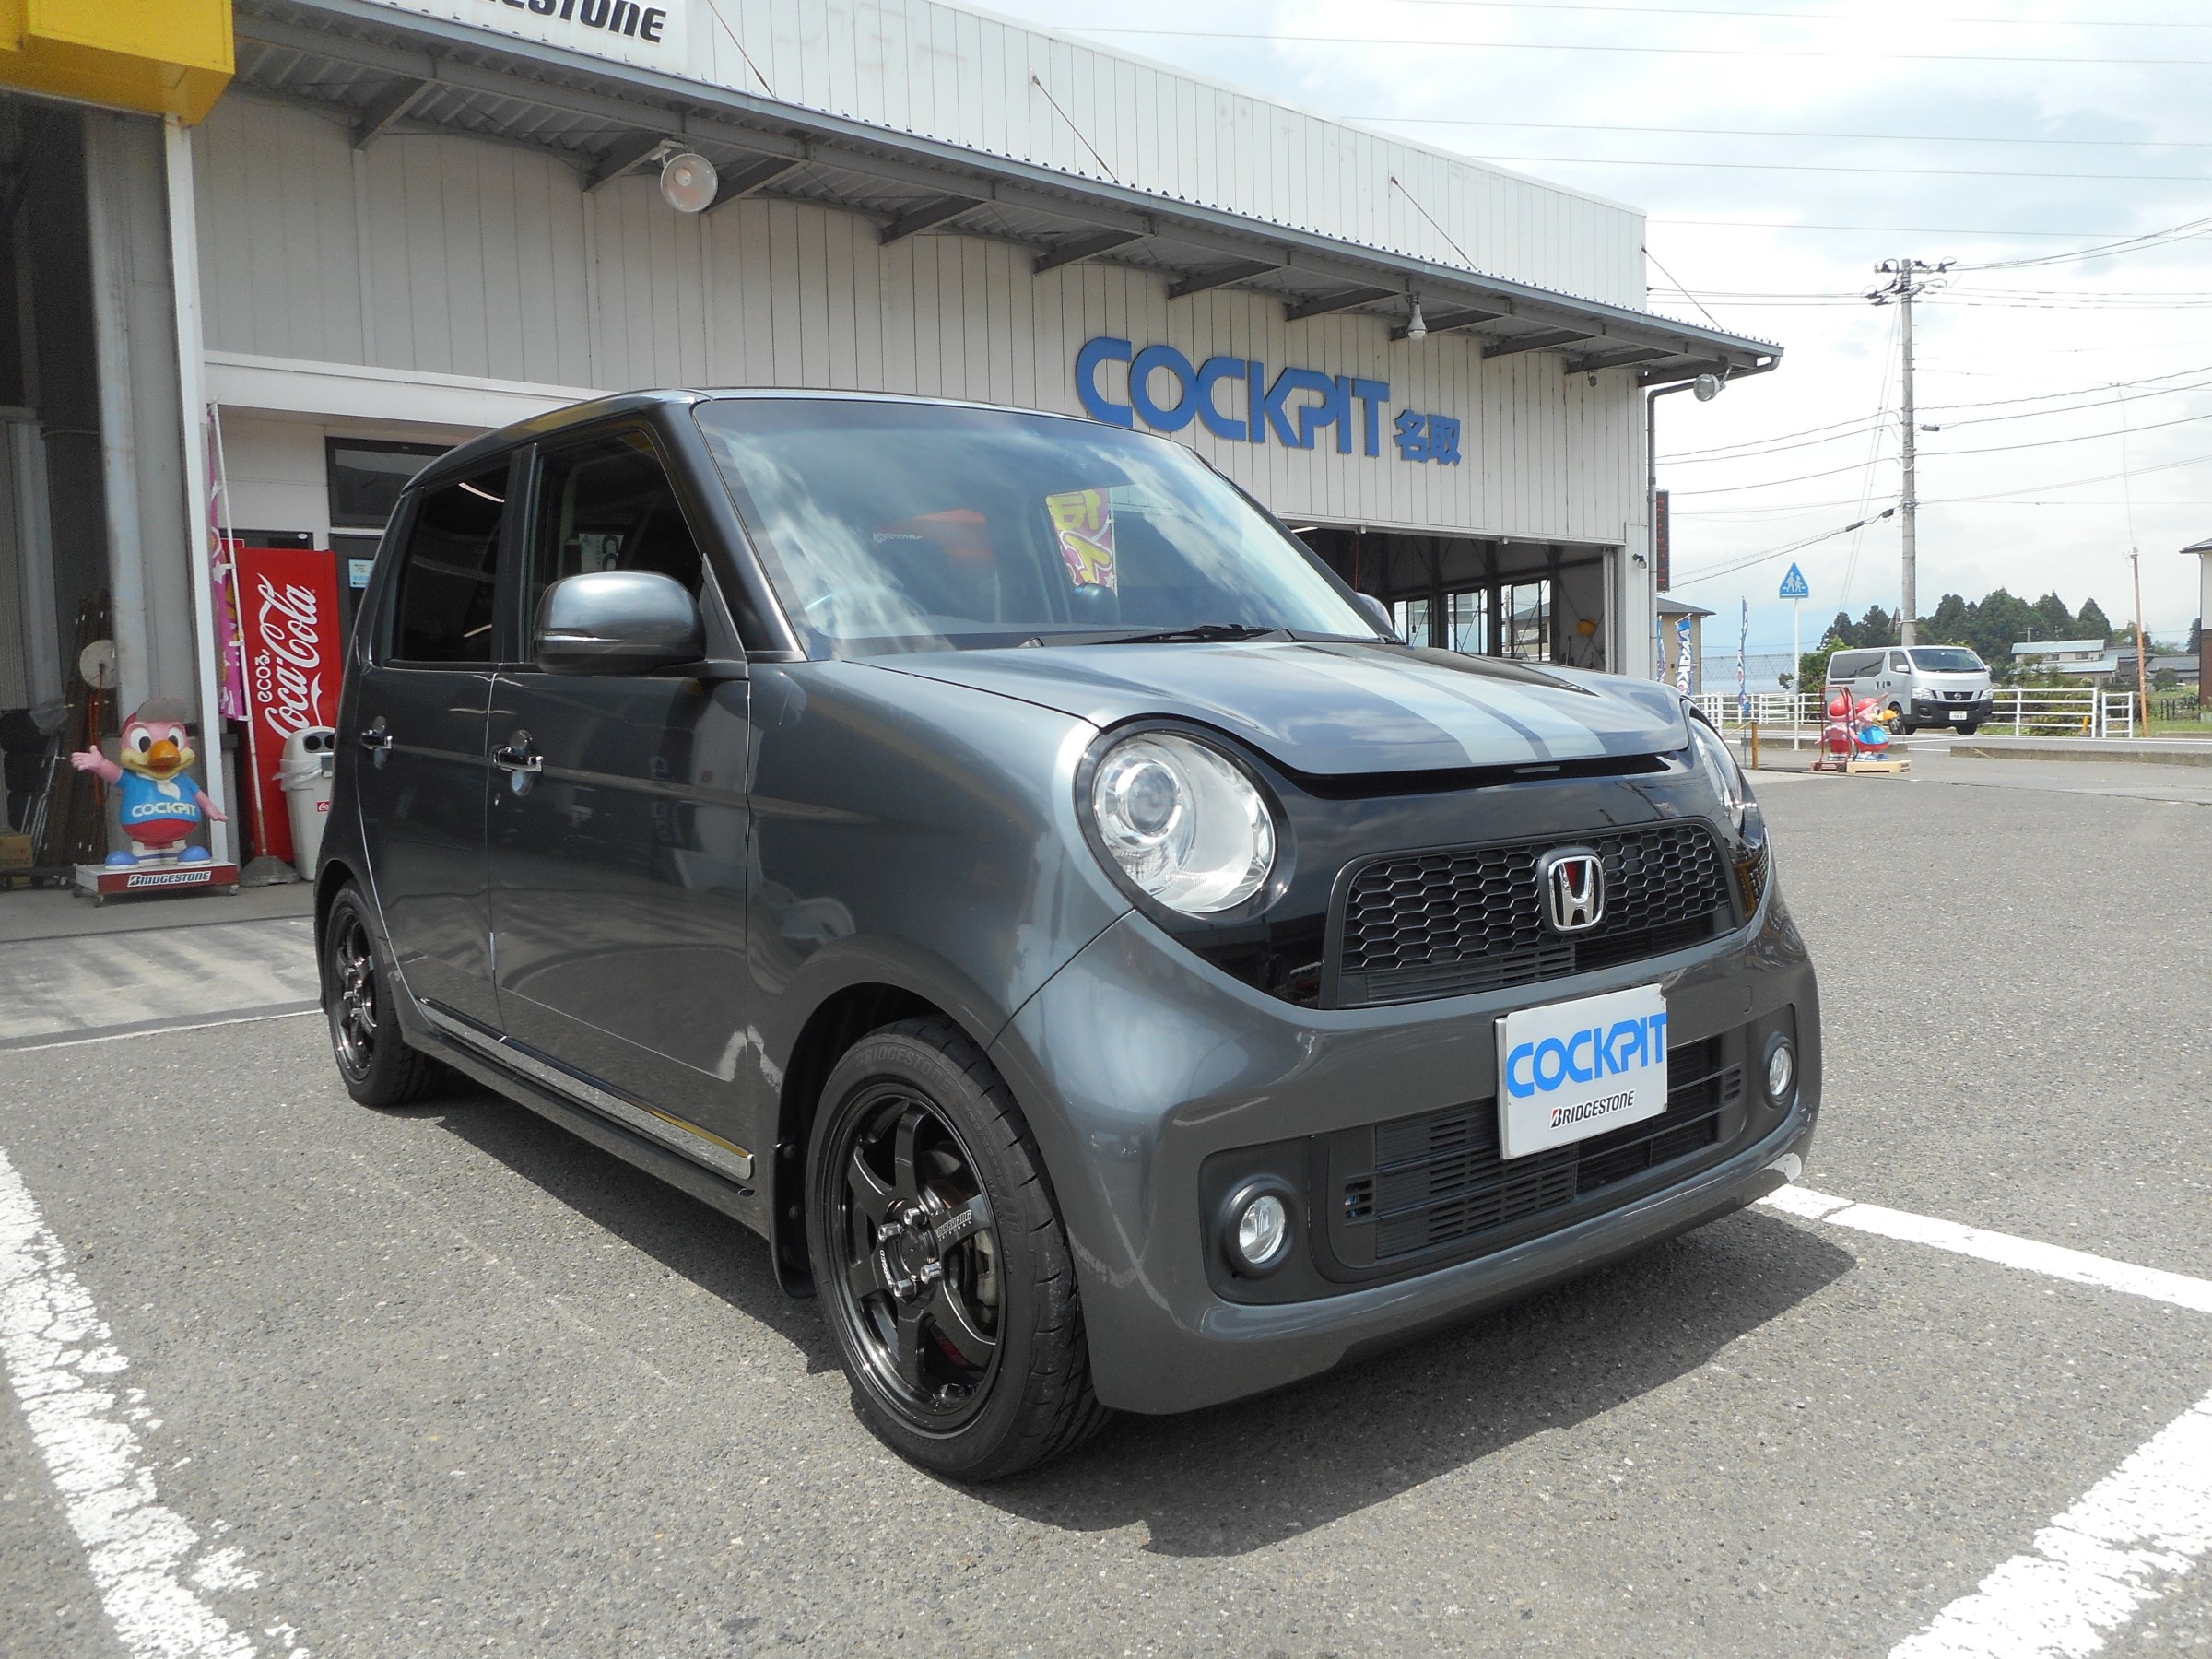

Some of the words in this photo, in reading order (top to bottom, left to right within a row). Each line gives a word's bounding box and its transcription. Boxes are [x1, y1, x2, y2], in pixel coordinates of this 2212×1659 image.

[1076, 336, 1390, 457] COCKPIT
[1394, 409, 1462, 465] 名取
[132, 802, 195, 818] COCKPIT
[129, 871, 210, 886] BRIDGESTONE
[1506, 1012, 1669, 1099] COCKPIT
[1551, 1090, 1635, 1128] BRIDGESTONE
